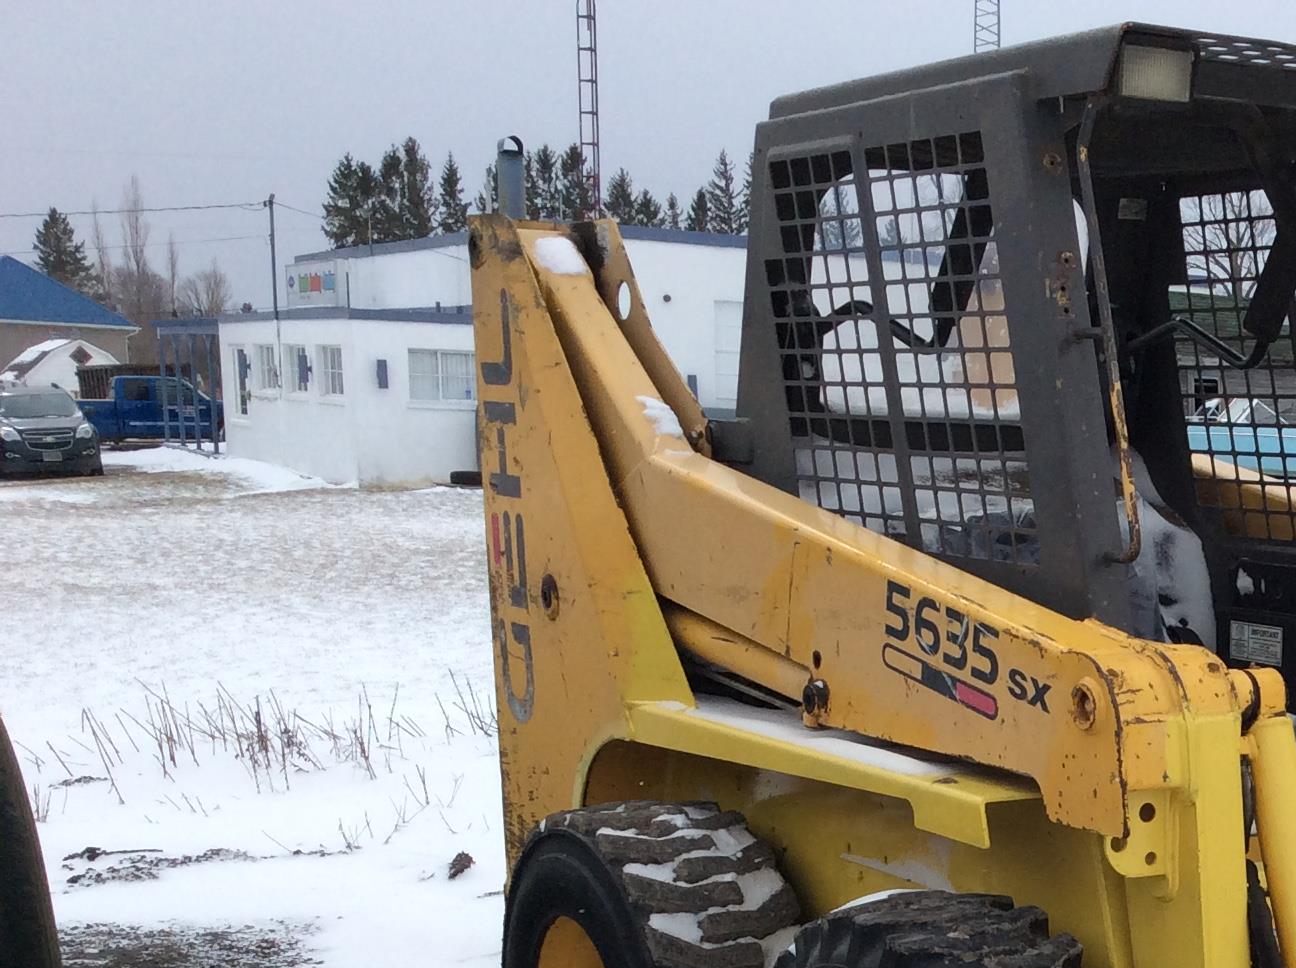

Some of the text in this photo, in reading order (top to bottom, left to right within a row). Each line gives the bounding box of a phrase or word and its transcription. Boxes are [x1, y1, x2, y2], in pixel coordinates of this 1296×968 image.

[481, 287, 535, 724] GEHL
[885, 579, 1052, 714] 5635 SX
